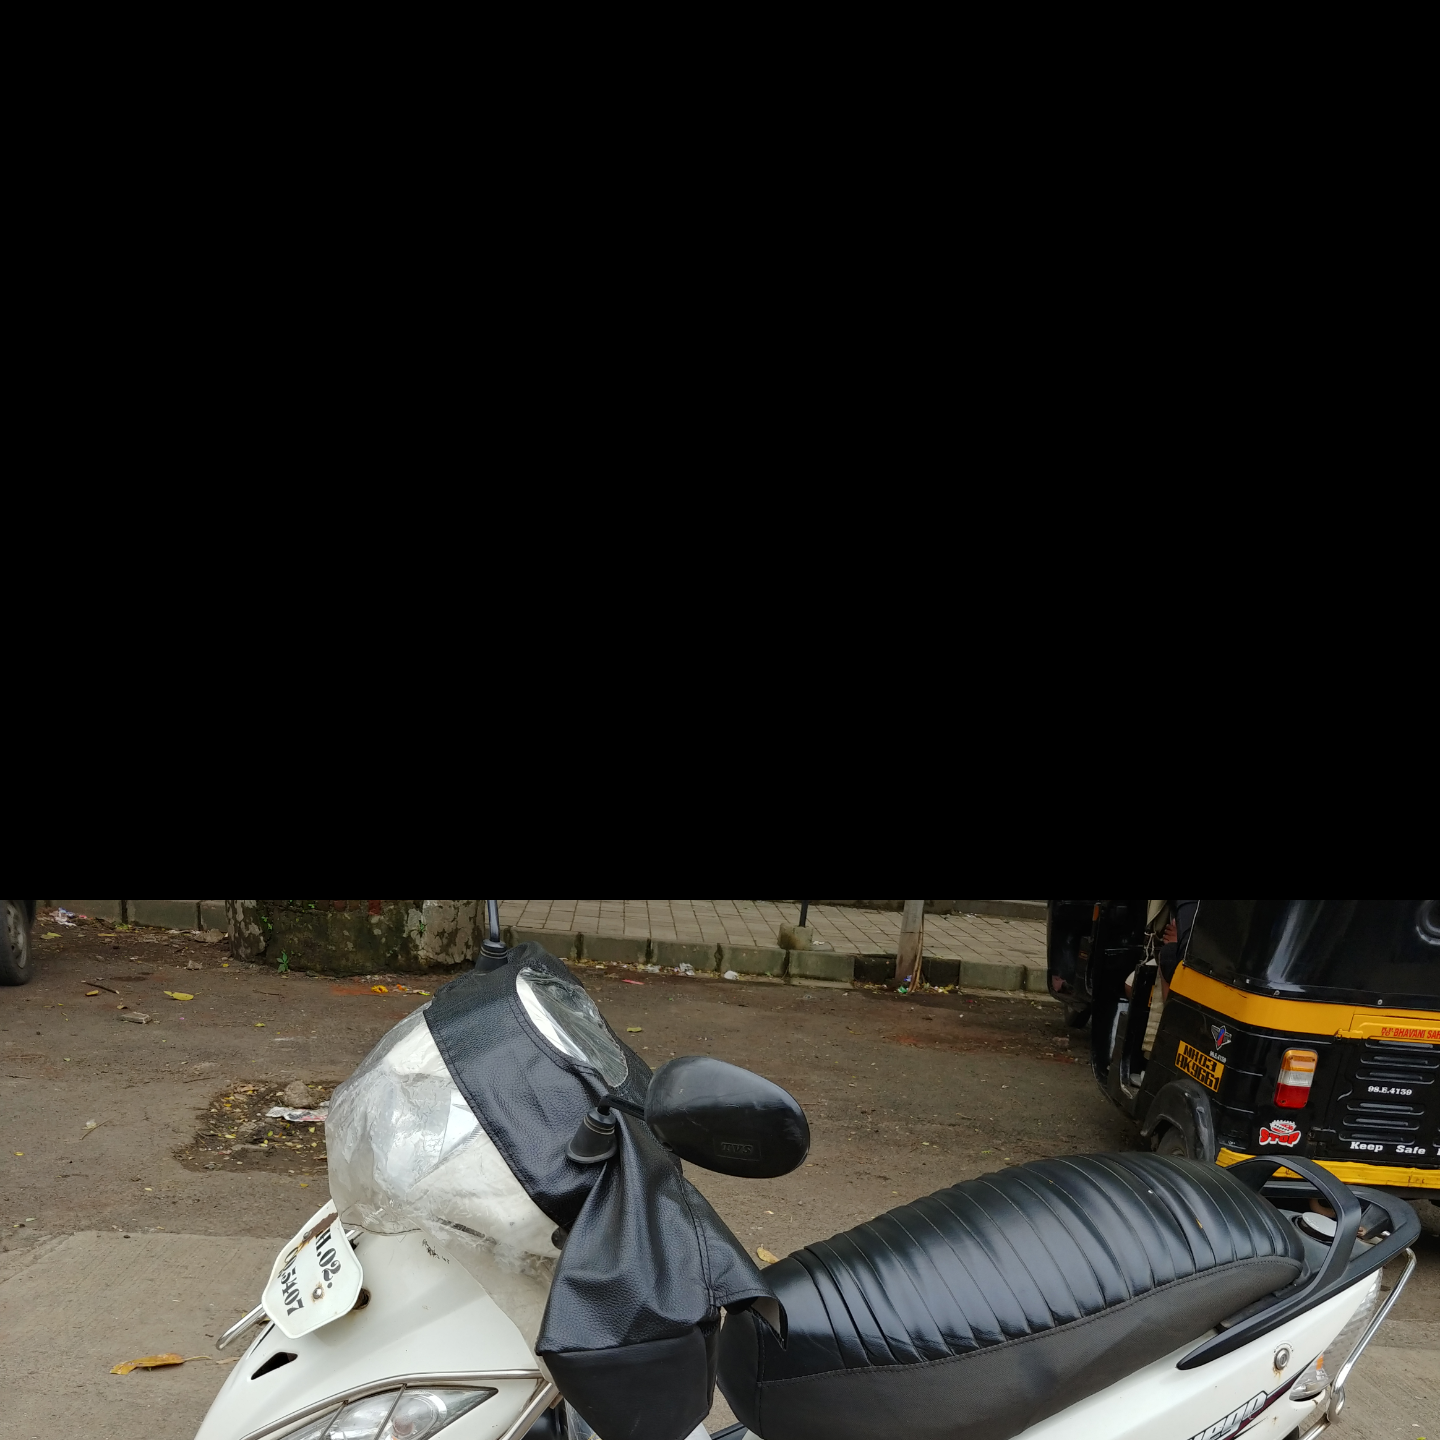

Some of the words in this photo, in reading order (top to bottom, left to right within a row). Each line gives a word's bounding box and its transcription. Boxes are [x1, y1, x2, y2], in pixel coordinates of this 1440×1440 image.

[1183, 1045, 1218, 1073] MH03
[1176, 1053, 1220, 1090] AK9661
[1260, 1128, 1301, 1146] STOP
[1350, 1141, 1383, 1152] Keep
[1395, 1144, 1426, 1155] Safe
